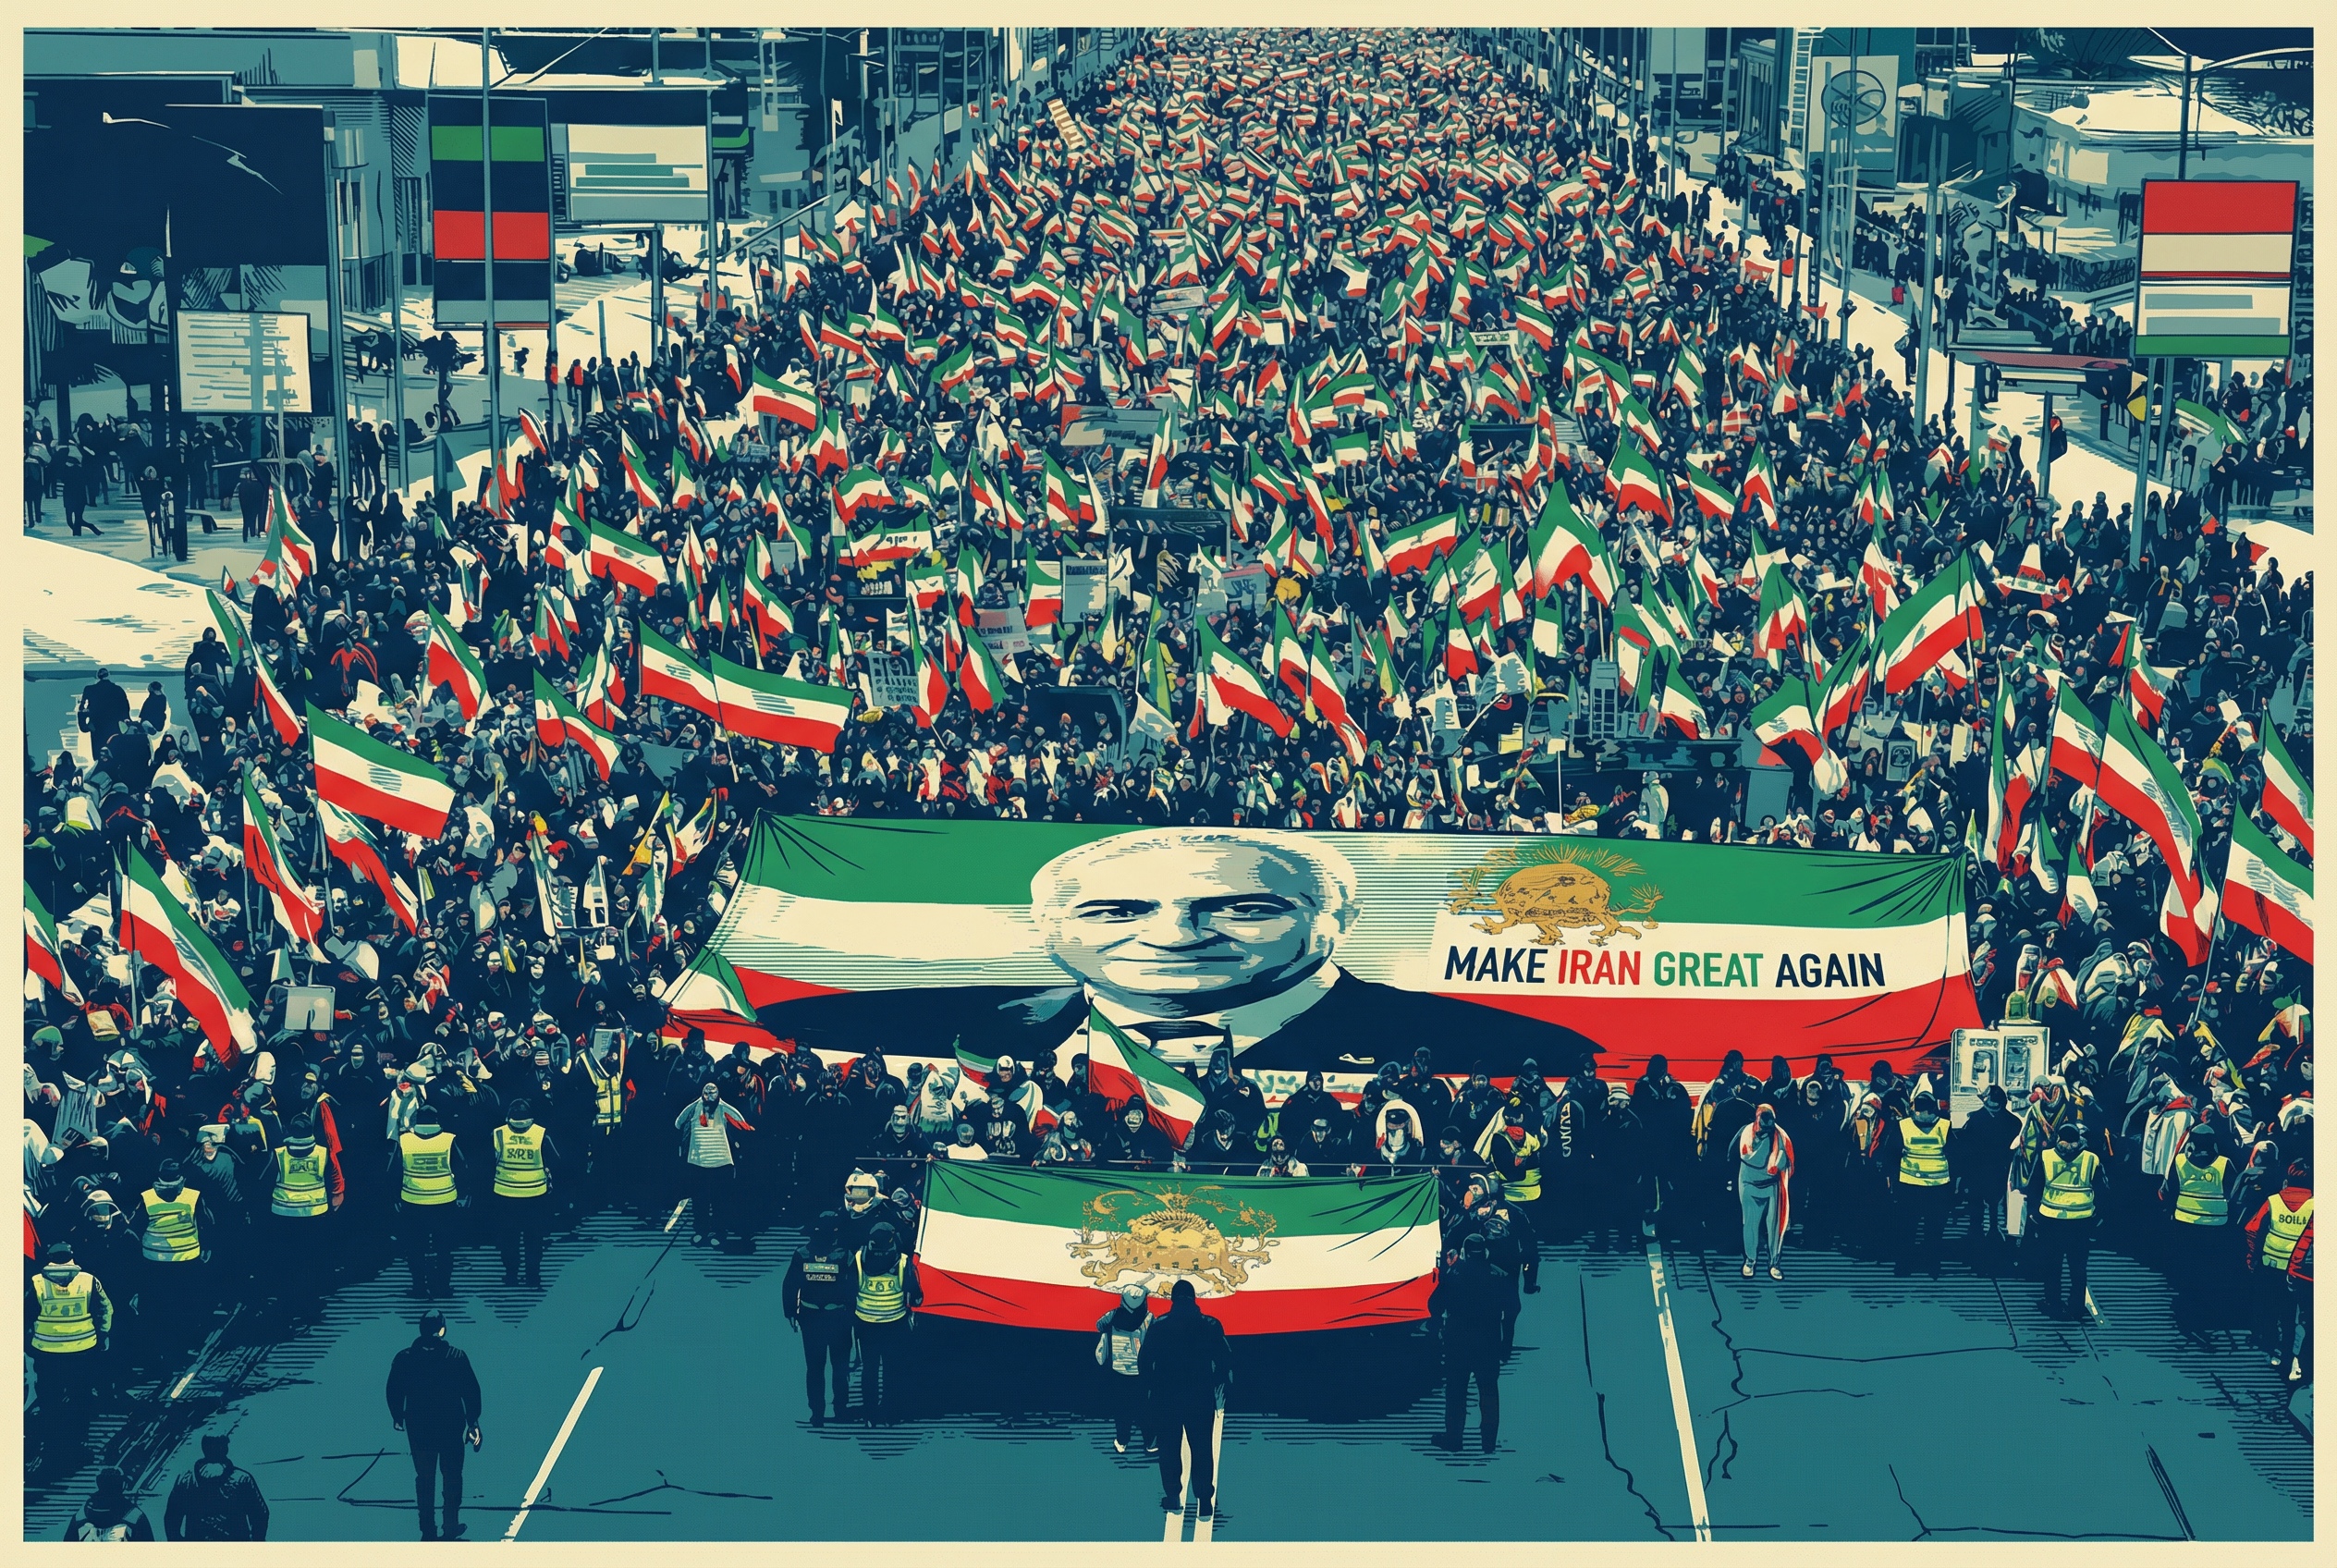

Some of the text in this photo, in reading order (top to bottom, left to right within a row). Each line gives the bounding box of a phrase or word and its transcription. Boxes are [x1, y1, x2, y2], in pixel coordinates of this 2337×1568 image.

[1443, 945, 1887, 988] MAKE IRAN GREAT AGAIN
